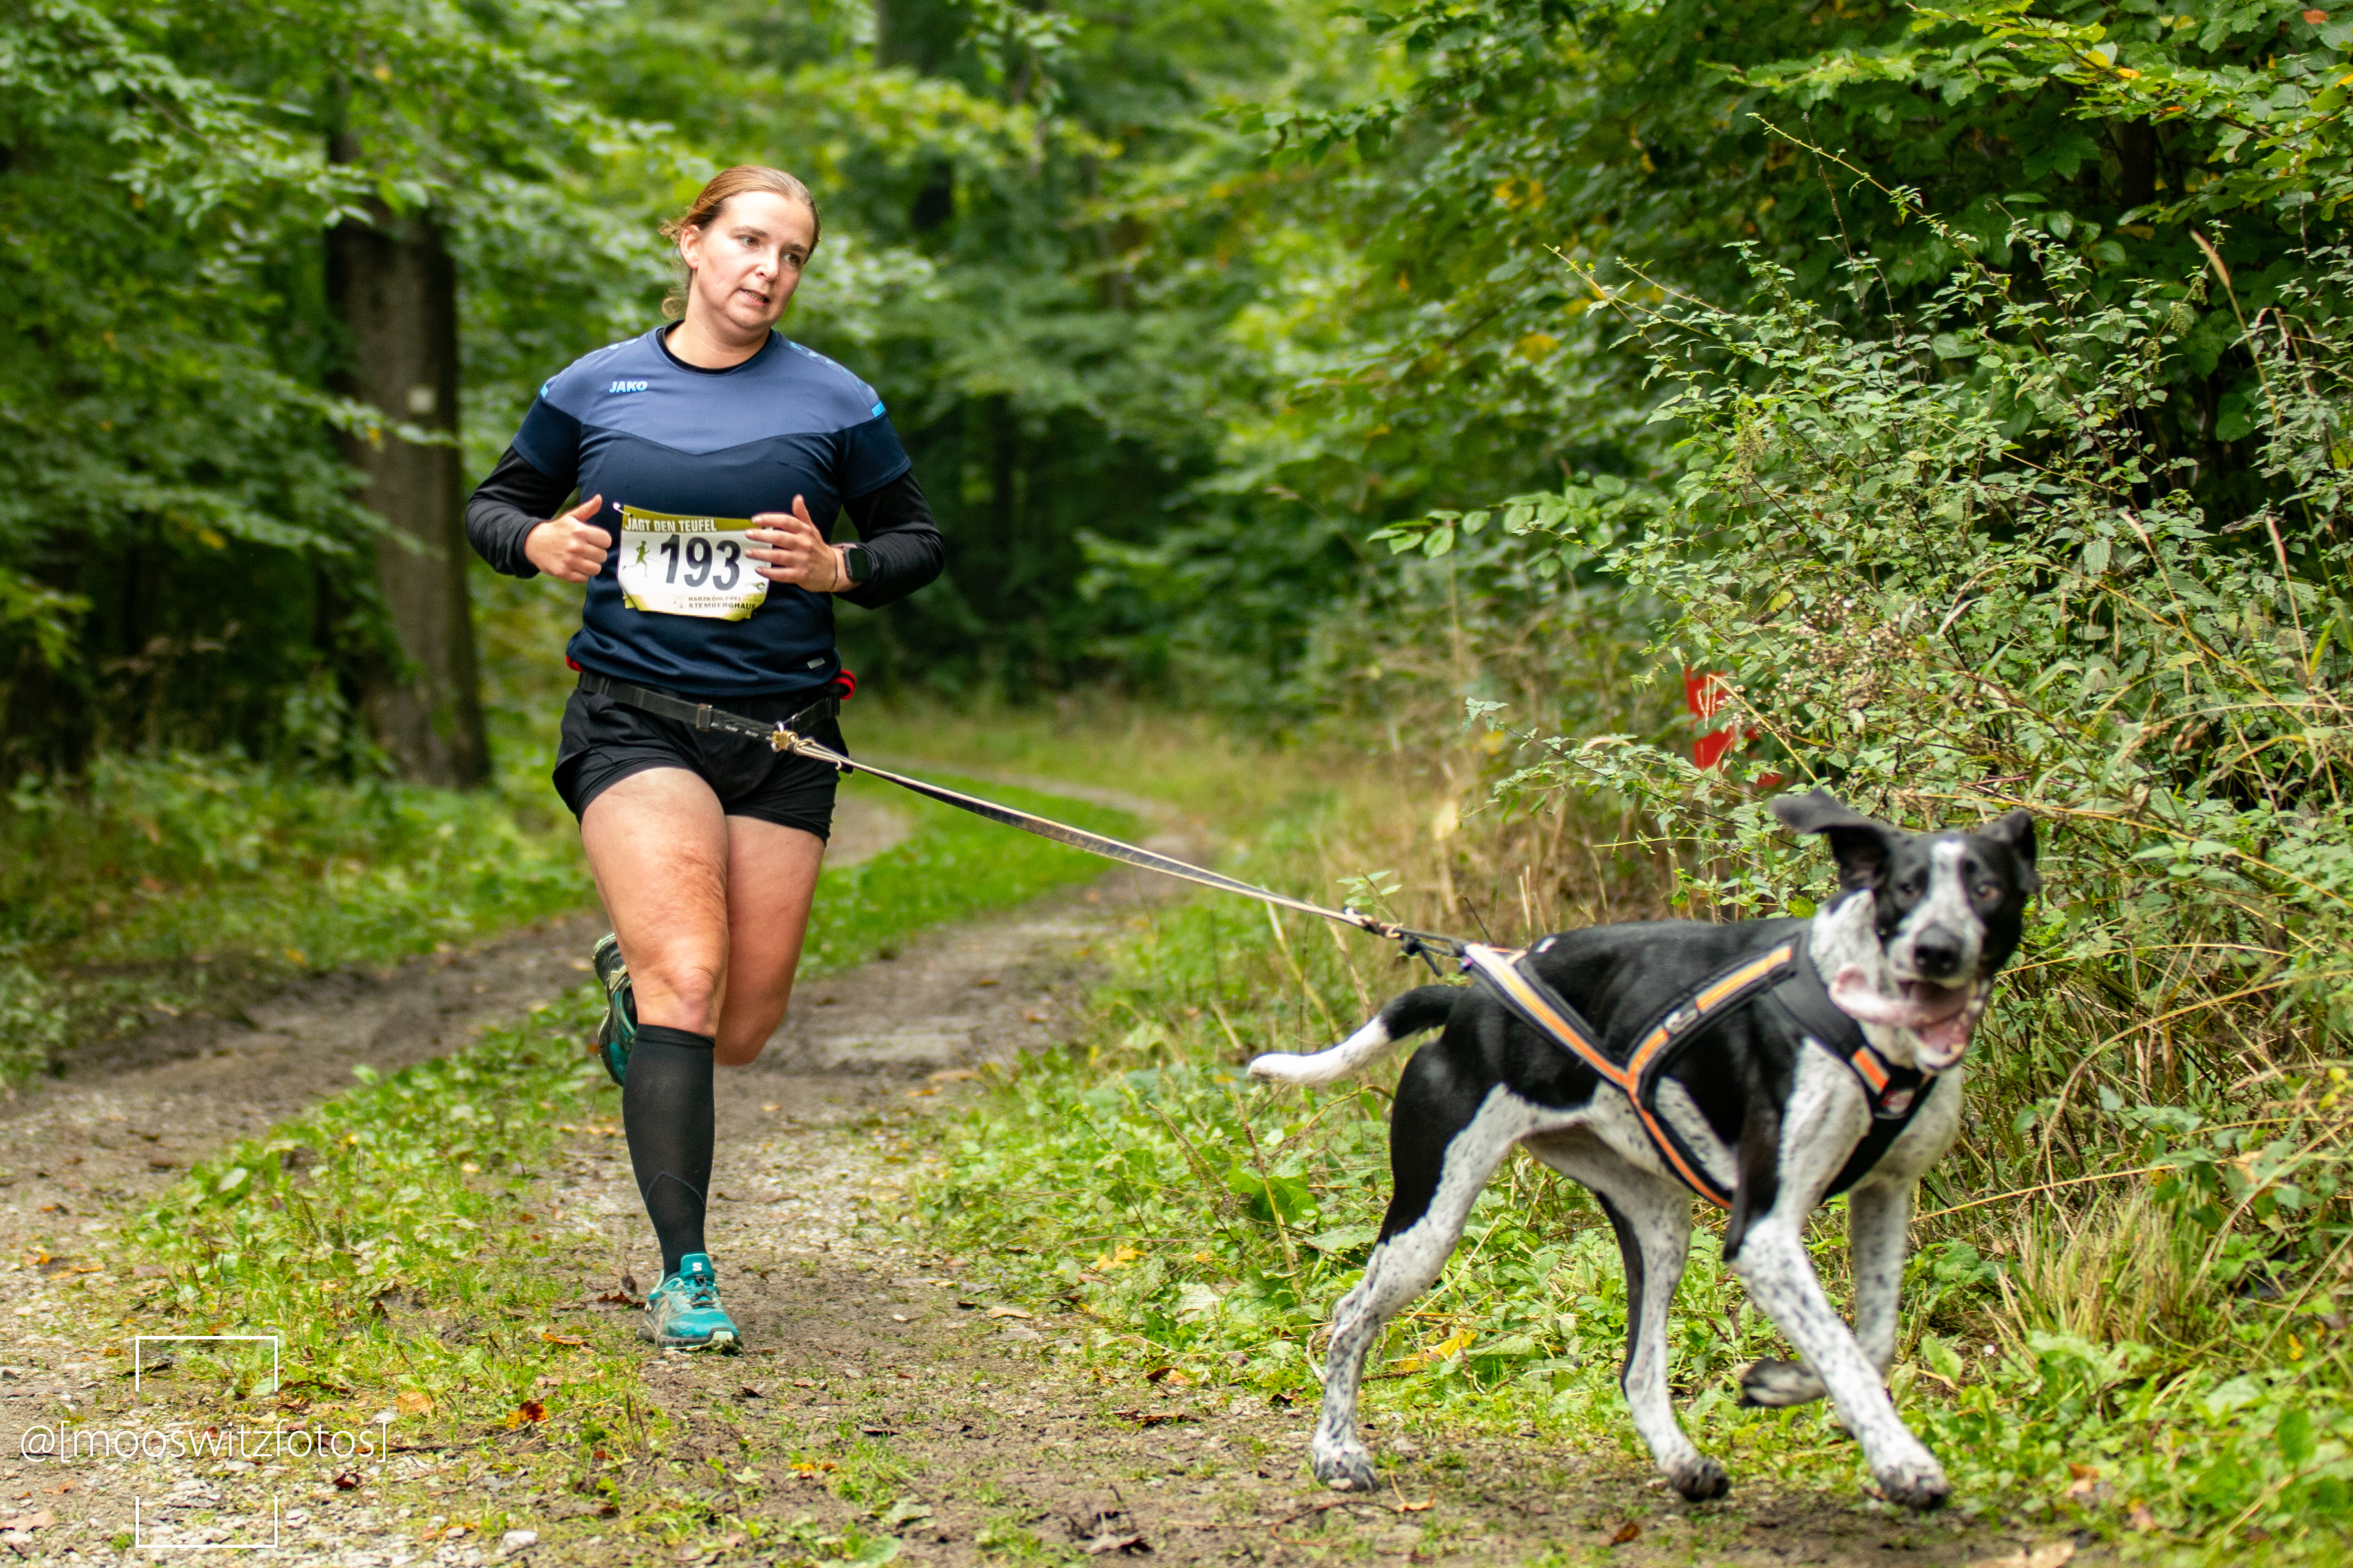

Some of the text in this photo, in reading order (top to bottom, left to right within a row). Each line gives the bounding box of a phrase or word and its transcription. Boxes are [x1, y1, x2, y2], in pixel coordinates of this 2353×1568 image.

[609, 381, 648, 393] JAKO
[625, 518, 717, 532] JAGT DEN TEUFEL
[660, 534, 741, 591] 193
